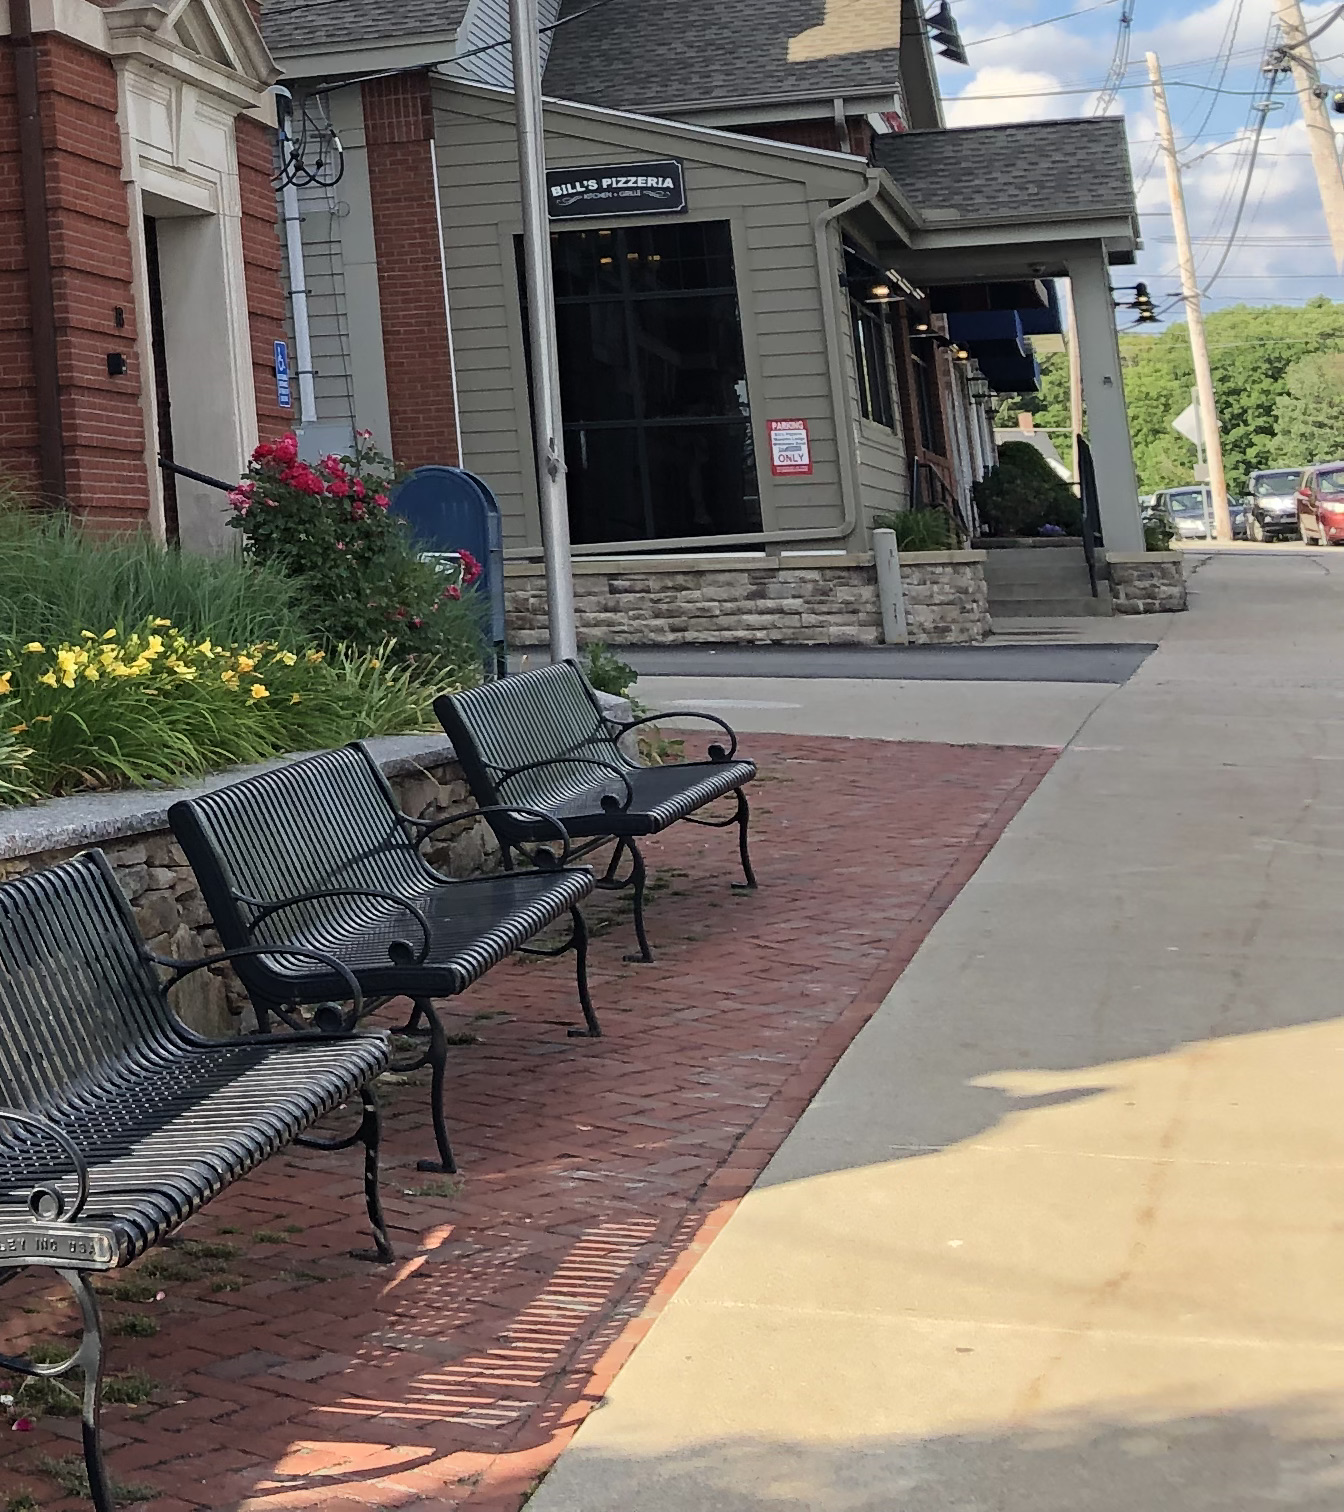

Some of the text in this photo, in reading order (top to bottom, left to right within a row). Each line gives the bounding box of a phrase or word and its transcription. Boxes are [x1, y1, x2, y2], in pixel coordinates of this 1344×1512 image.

[551, 176, 675, 197] BILL'S PIZZERIA
[778, 453, 803, 463] ONLY
